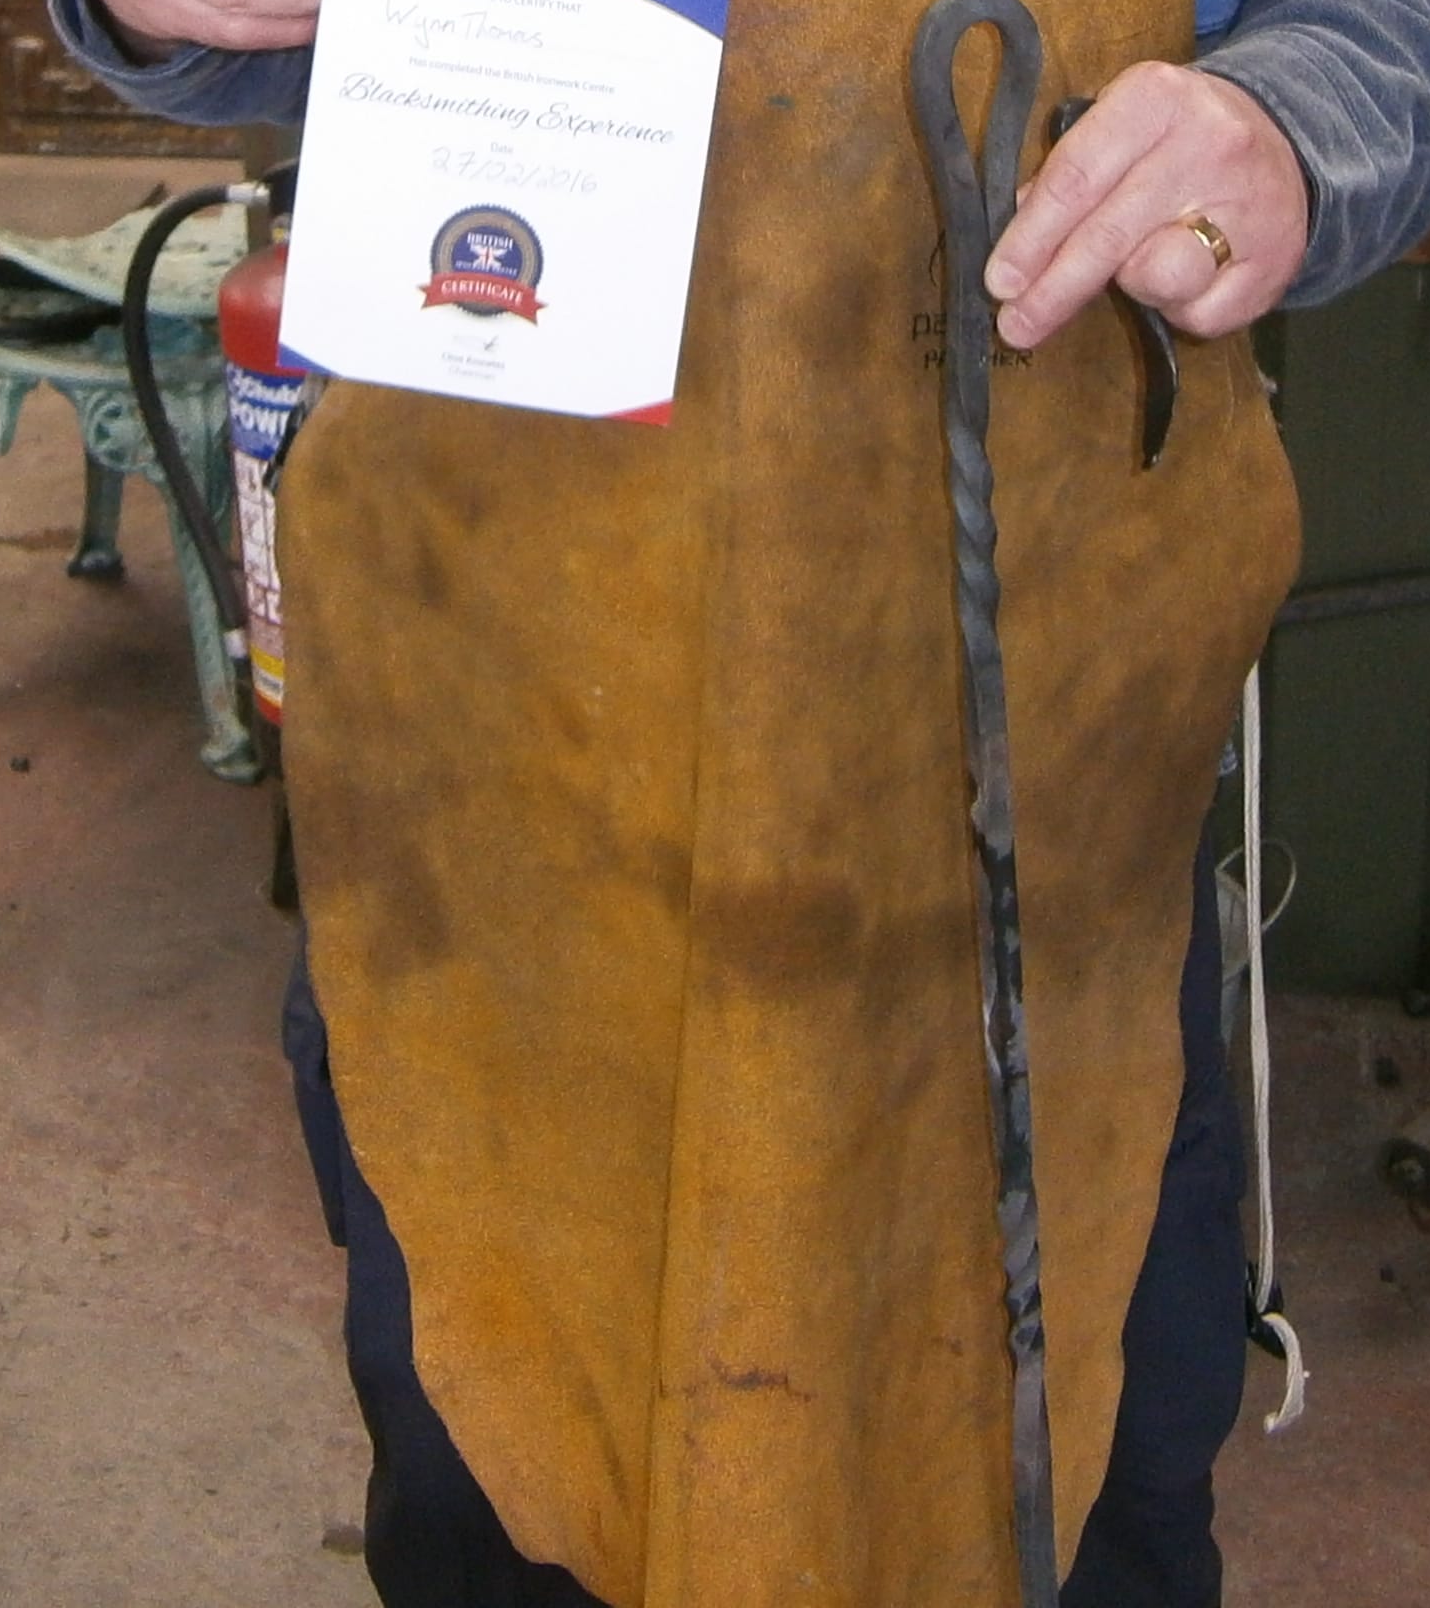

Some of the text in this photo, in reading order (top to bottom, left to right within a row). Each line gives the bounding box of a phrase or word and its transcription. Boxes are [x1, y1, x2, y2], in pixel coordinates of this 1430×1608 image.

[556, 0, 582, 14] THAT
[339, 73, 675, 144] Blacksmithing Experience
[441, 279, 523, 306] CERTIFICATE
